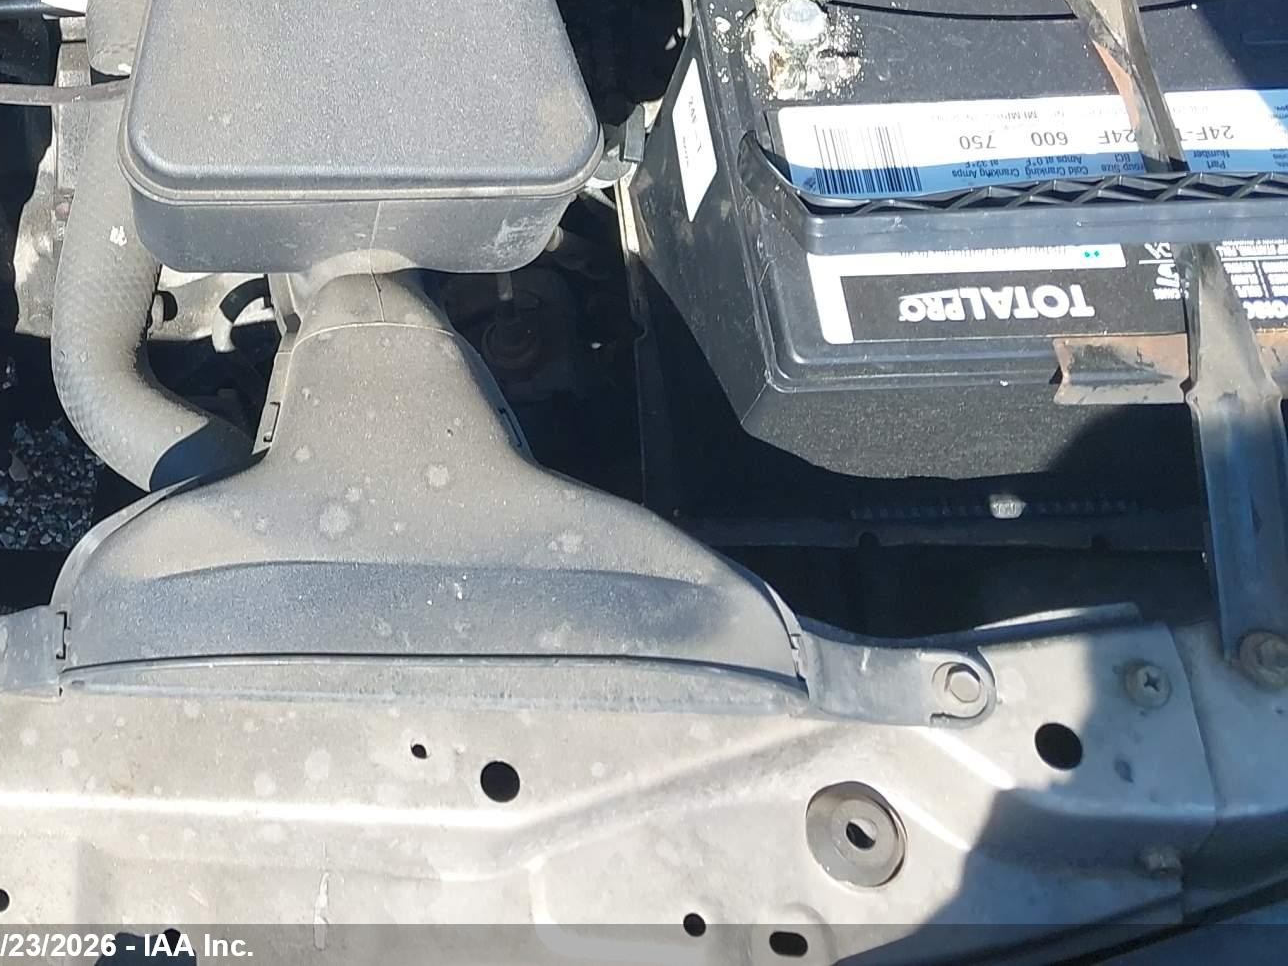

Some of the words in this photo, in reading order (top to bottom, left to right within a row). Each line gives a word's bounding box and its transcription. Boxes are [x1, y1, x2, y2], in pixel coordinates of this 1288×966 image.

[1030, 130, 1069, 148] 600
[1096, 128, 1134, 145] 24F
[958, 135, 997, 151] 750
[1044, 155, 1054, 165] at
[1055, 154, 1083, 165] Amps
[1192, 150, 1231, 160] Number
[1100, 163, 1120, 173] Size
[1121, 162, 1145, 172] roup
[1206, 159, 1226, 170] Part
[951, 168, 978, 180] Amps
[978, 167, 1020, 179] Cranking
[1024, 164, 1067, 179] Cranking
[1067, 165, 1090, 176] Cold
[898, 284, 1096, 322] TOTALPRO
